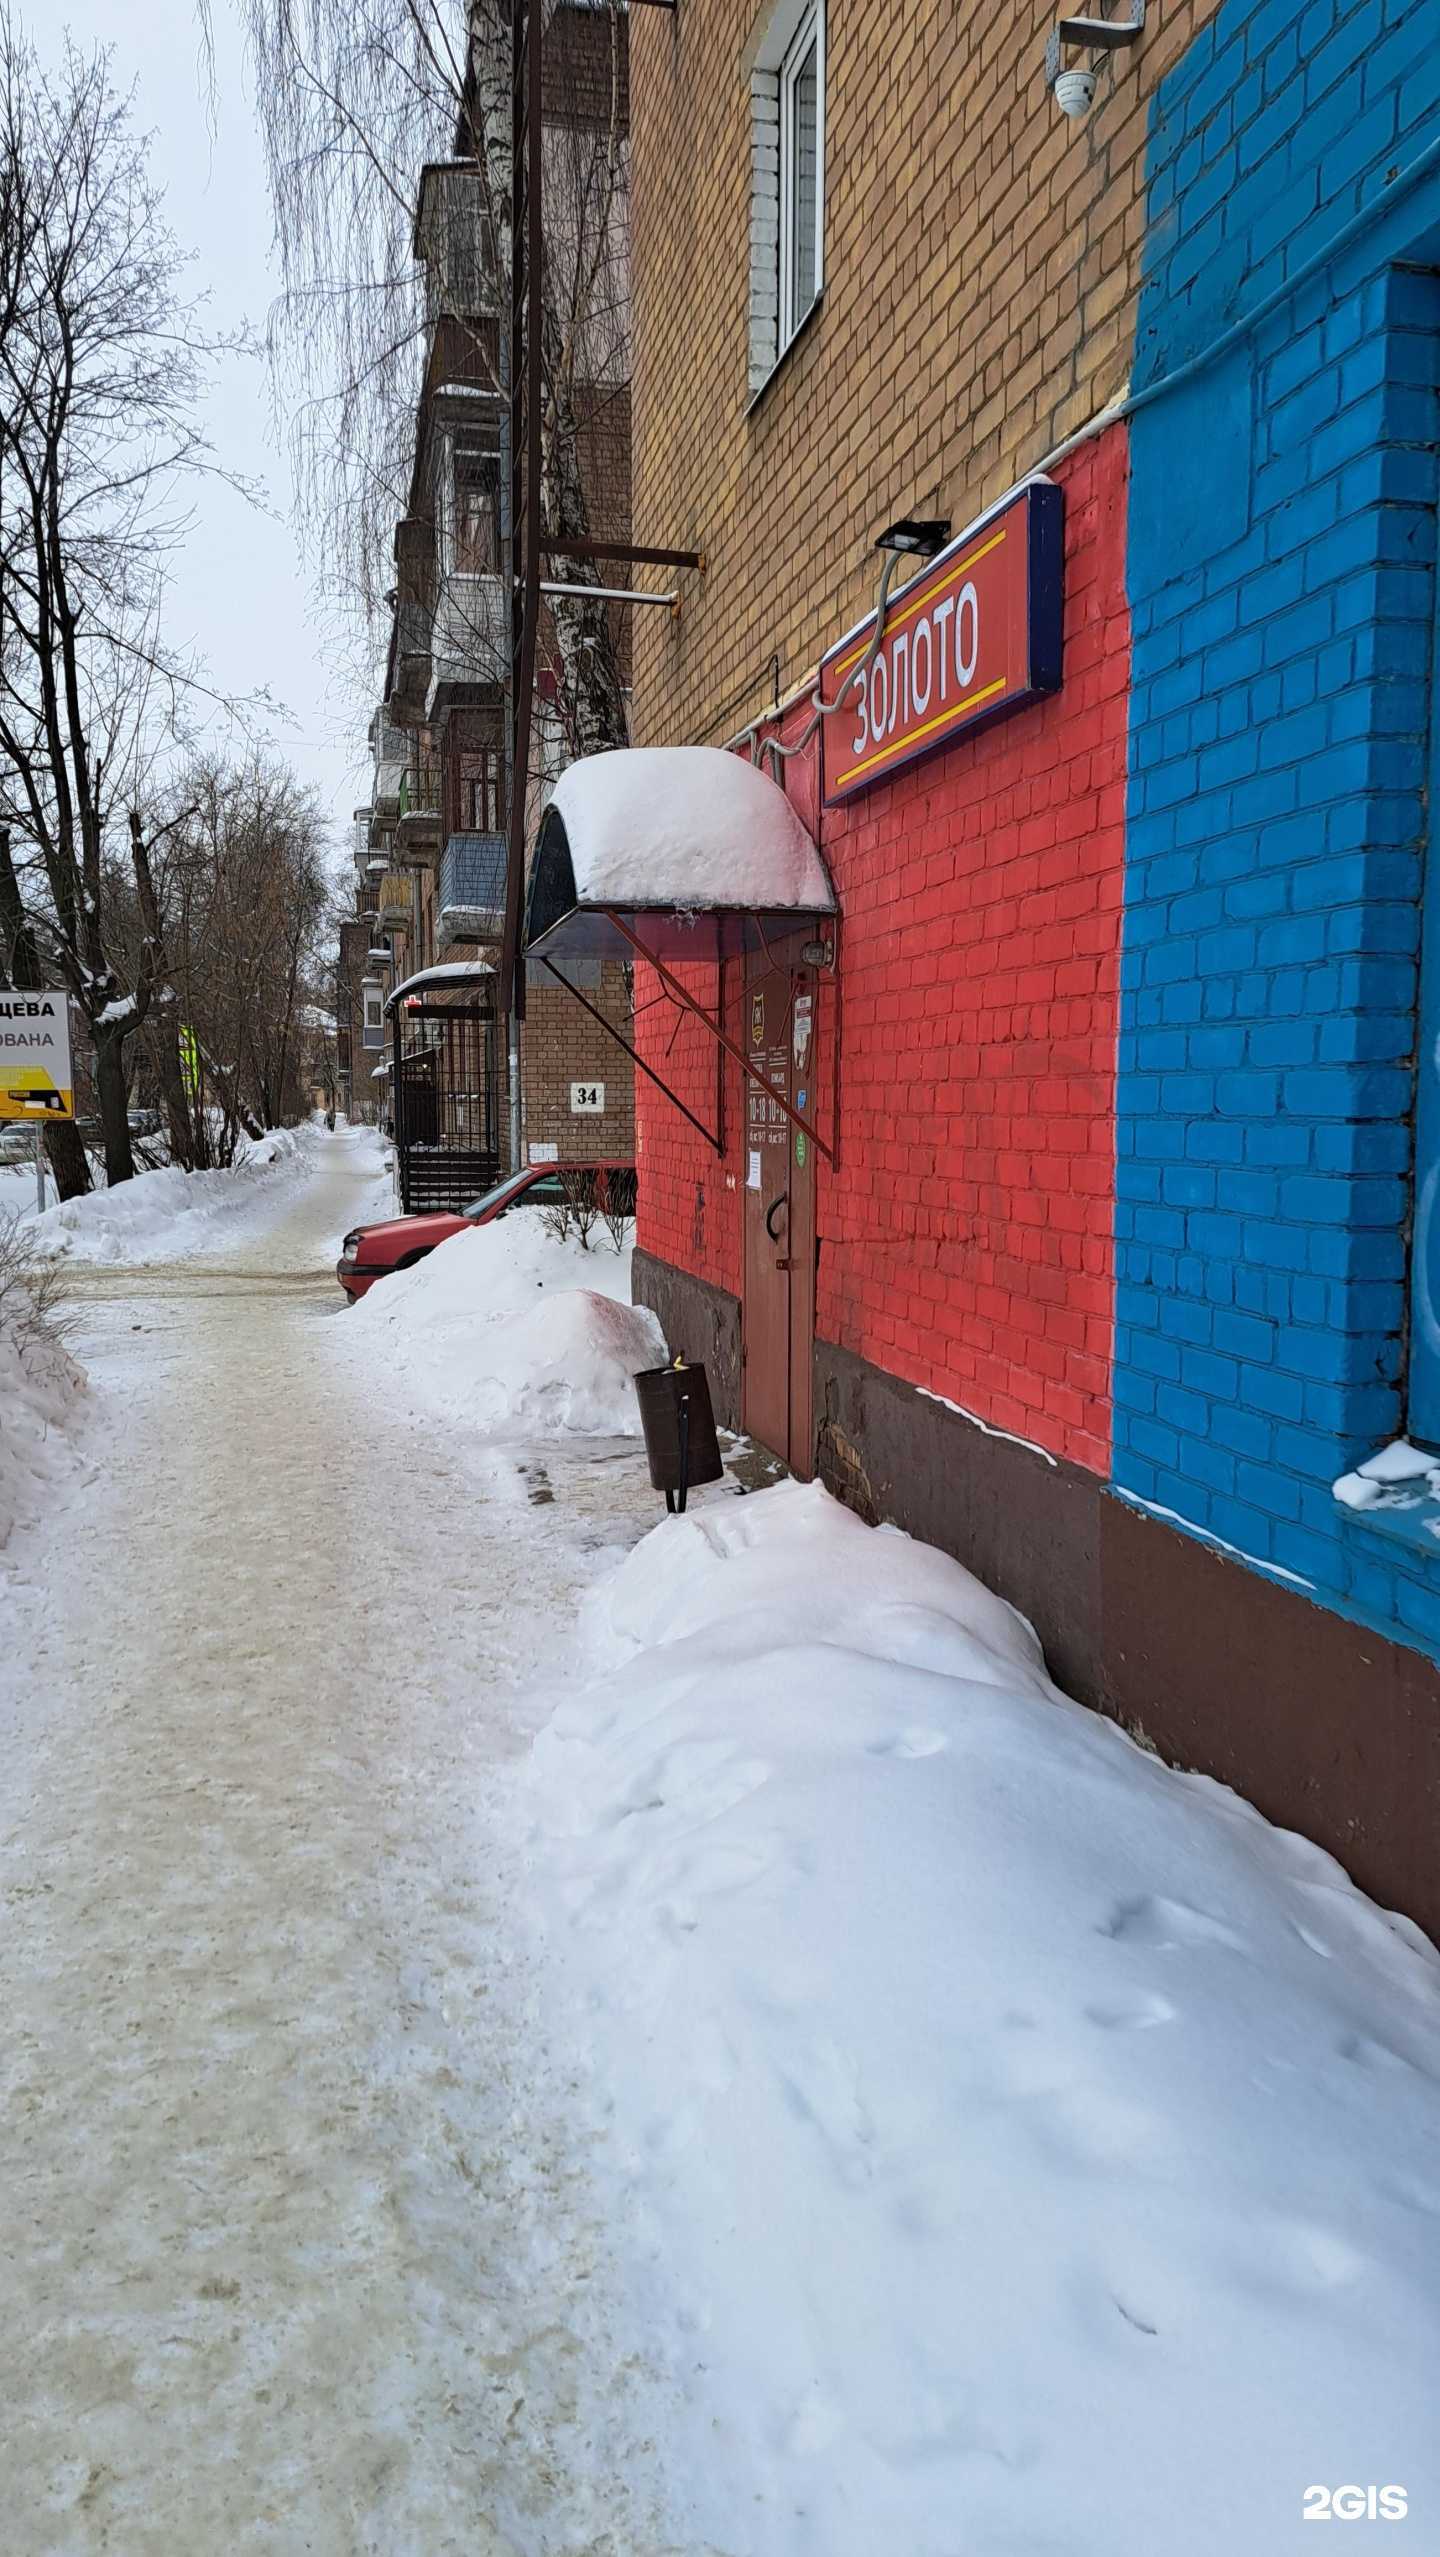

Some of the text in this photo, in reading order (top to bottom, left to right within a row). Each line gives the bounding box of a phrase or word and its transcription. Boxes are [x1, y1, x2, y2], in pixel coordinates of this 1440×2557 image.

[851, 580, 979, 755] ЗОЛОТО
[0, 1032, 54, 1047] ВАНА
[577, 1087, 597, 1105] 34
